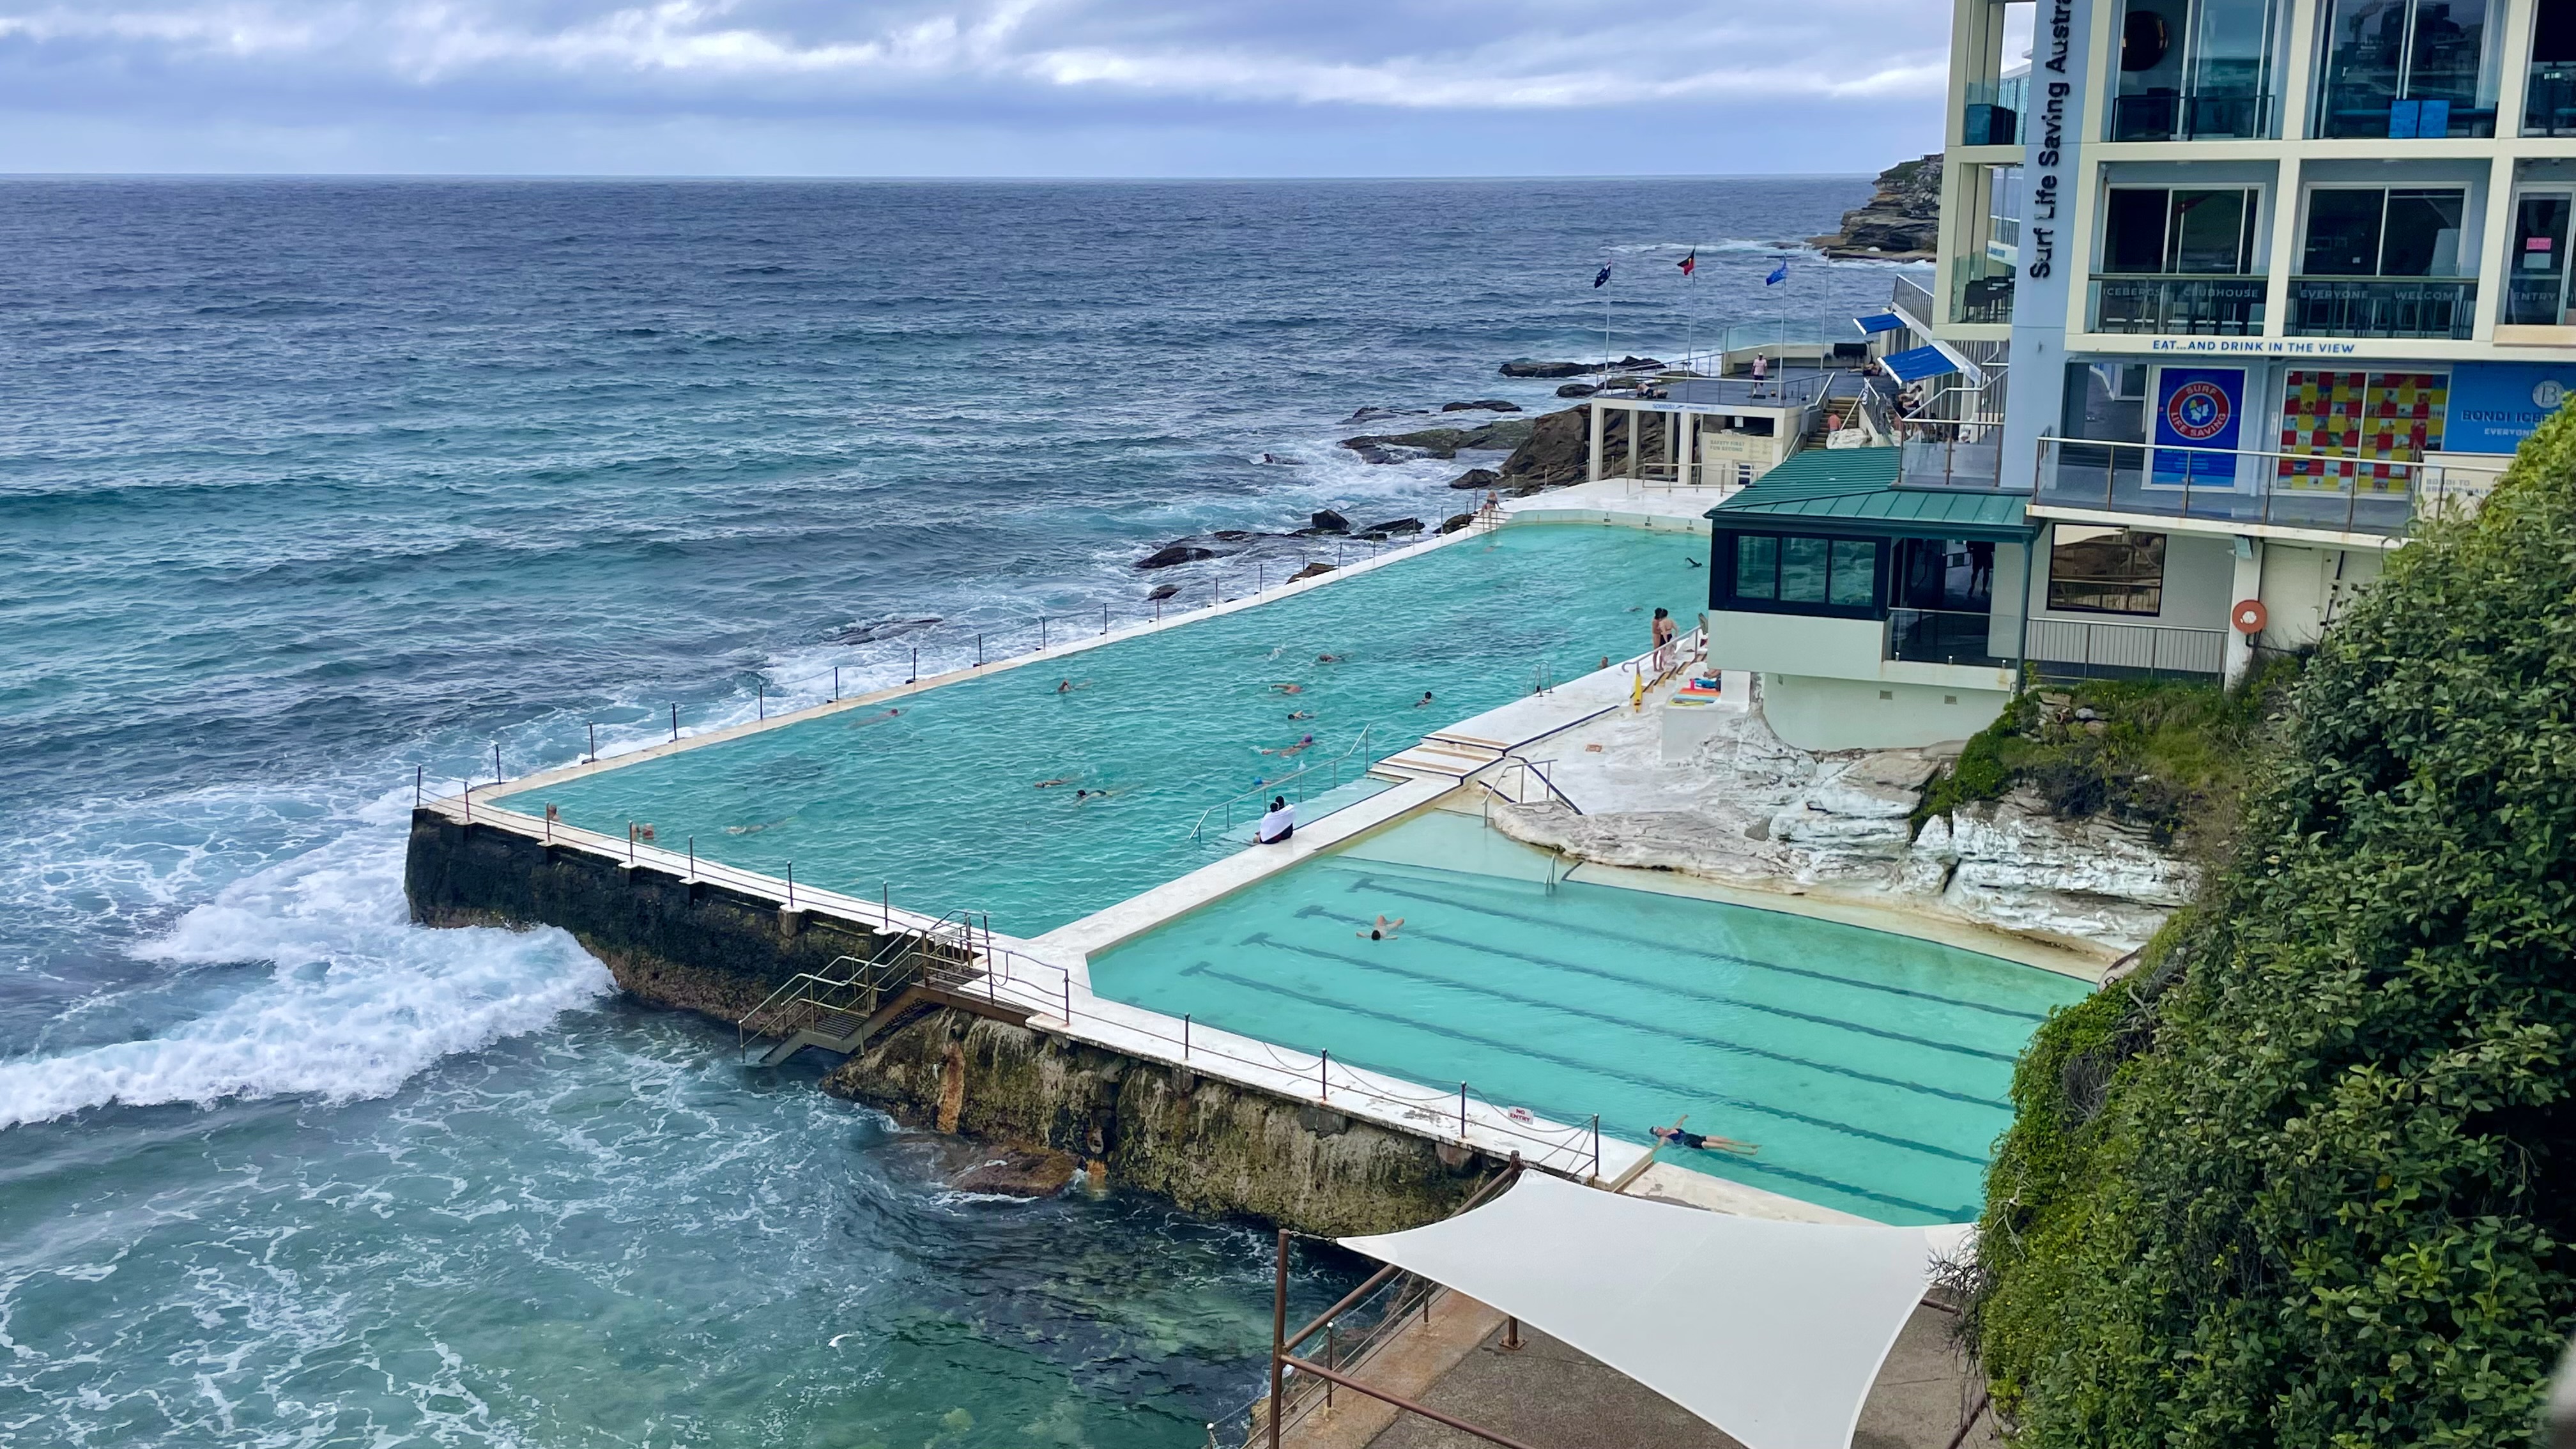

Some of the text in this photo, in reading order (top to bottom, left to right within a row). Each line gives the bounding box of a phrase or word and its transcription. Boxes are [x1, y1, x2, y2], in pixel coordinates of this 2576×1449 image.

[2038, 82, 2070, 167] Saving
[2034, 175, 2057, 220] Life
[2030, 227, 2053, 279] Surf
[2183, 288, 2259, 298] CLUBHOUSE
[2299, 289, 2369, 300] EVERYONE
[2221, 341, 2264, 351] DRINK
[2269, 342, 2283, 351] IN
[2287, 342, 2313, 352] THE
[2319, 343, 2355, 353] VIEW
[2186, 385, 2218, 395] SURF
[2462, 410, 2510, 422] BONDI
[2170, 412, 2227, 436] LIFE SAVING
[1510, 1113, 1530, 1122] ENTRY
